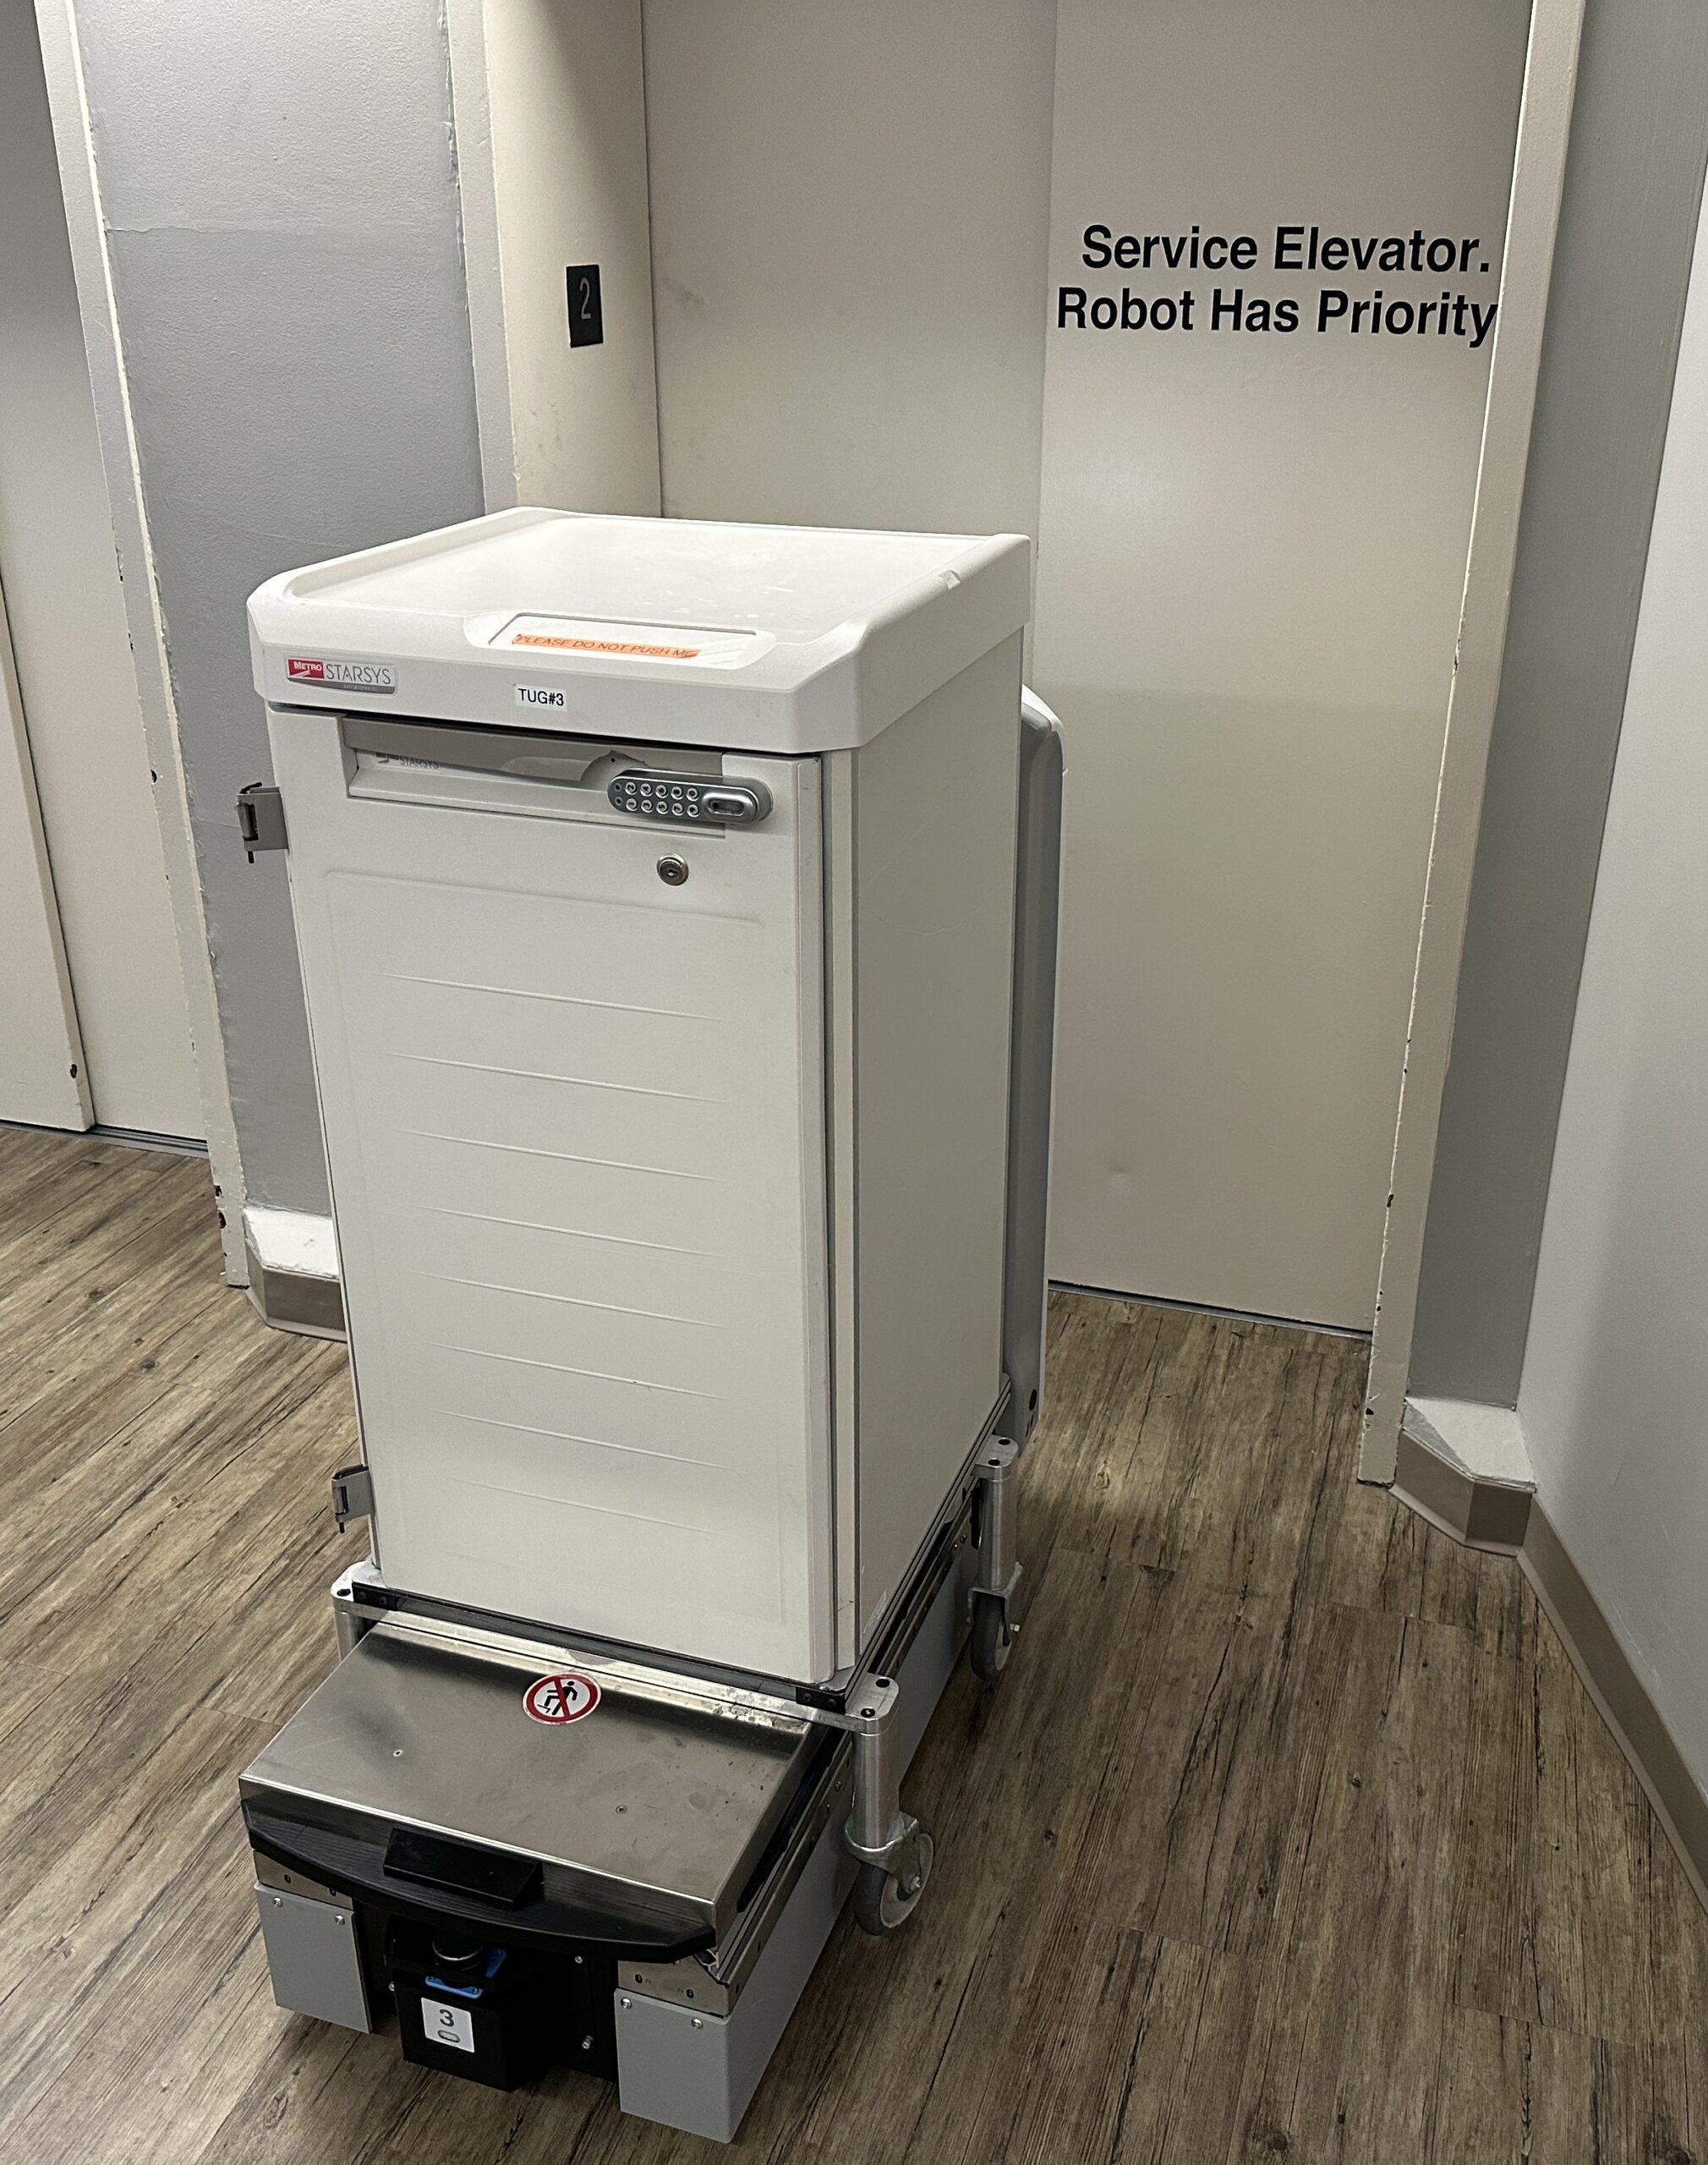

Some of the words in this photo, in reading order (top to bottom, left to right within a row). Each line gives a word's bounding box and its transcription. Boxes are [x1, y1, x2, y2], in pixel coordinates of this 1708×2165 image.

[1081, 223, 1258, 270] Service
[1273, 226, 1491, 272] Elevator.
[579, 277, 592, 320] 2
[1057, 286, 1195, 332] Robot
[1211, 288, 1300, 332] Has
[1317, 289, 1499, 348] Priority
[516, 635, 569, 647] PLEASE
[572, 640, 595, 649] DO
[598, 642, 631, 652] NOT
[630, 645, 671, 656] PUSH
[293, 660, 322, 671] METRO
[326, 663, 391, 685] STARSYS
[517, 688, 565, 706] TUG#3
[439, 2009, 455, 2027] 3
